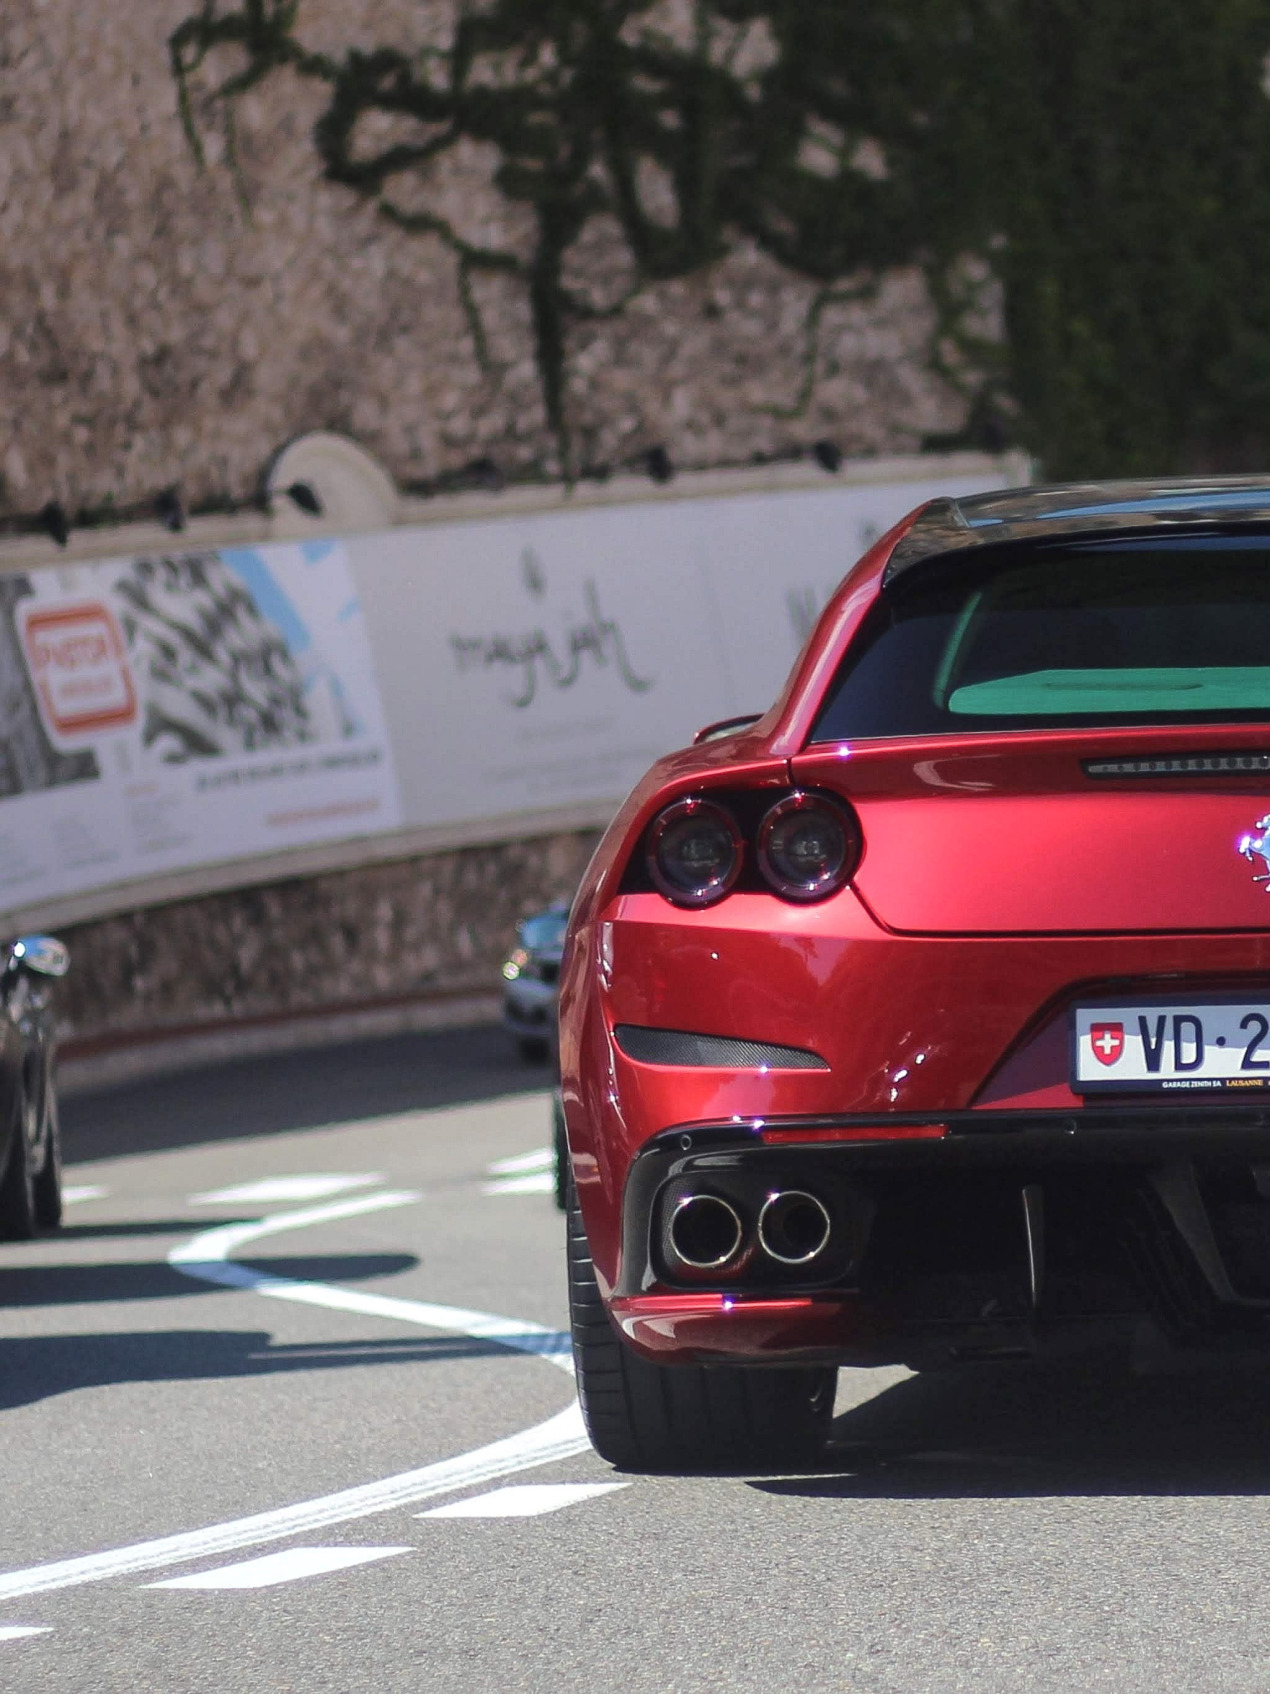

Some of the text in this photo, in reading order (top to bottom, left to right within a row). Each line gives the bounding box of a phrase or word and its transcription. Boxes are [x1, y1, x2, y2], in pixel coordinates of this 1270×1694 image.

[1161, 1080, 1190, 1089] GARAGE
[1212, 1080, 1222, 1088] SA
[1225, 1079, 1264, 1087] LAUSANNE
